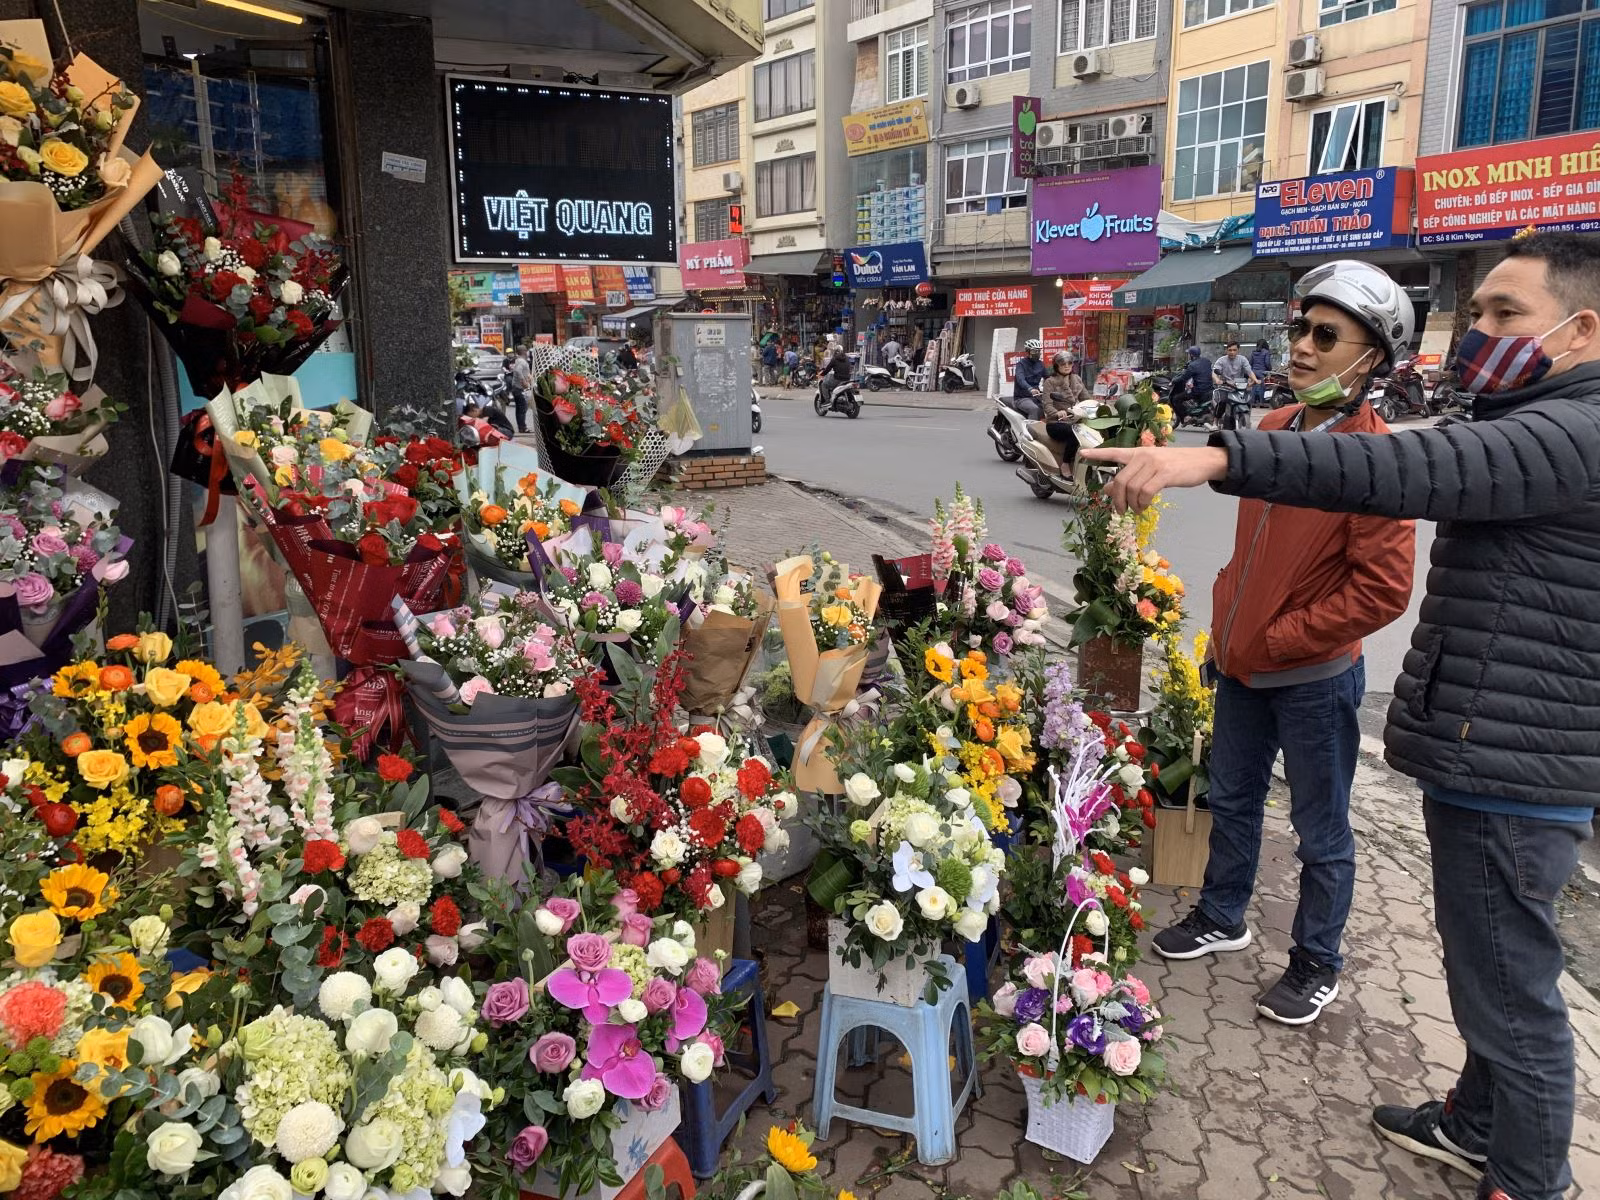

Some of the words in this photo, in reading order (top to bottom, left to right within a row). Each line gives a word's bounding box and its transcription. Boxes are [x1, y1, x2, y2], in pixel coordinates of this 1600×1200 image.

[1423, 165, 1481, 191] INOX
[1487, 156, 1553, 184] MINH
[1261, 185, 1278, 194] NPG
[1435, 195, 1472, 209] CHUYÊN:
[1490, 188, 1507, 204] BẾP
[1510, 188, 1533, 202] INOX
[1543, 182, 1562, 198] BẾP
[1566, 182, 1583, 196] GIA
[483, 189, 549, 239] VIỆT
[556, 199, 653, 236] QUANG
[1281, 208, 1295, 216] GẠCH
[1311, 205, 1326, 213] GẠCH
[1332, 209, 1372, 231] THẢO
[1423, 214, 1439, 228] BẾP
[1442, 211, 1467, 226] CÔNG
[1469, 210, 1502, 225] NGHIỆP
[1505, 208, 1517, 221] VÀ
[1520, 205, 1540, 220] CÁC
[1567, 201, 1595, 216] HÀNG
[1036, 219, 1080, 243] Klever
[1105, 214, 1153, 238] Fruits
[853, 263, 881, 275] Dulux
[959, 292, 972, 302] CHO
[974, 290, 991, 302] THUÊ
[1008, 289, 1028, 299] HÀNG
